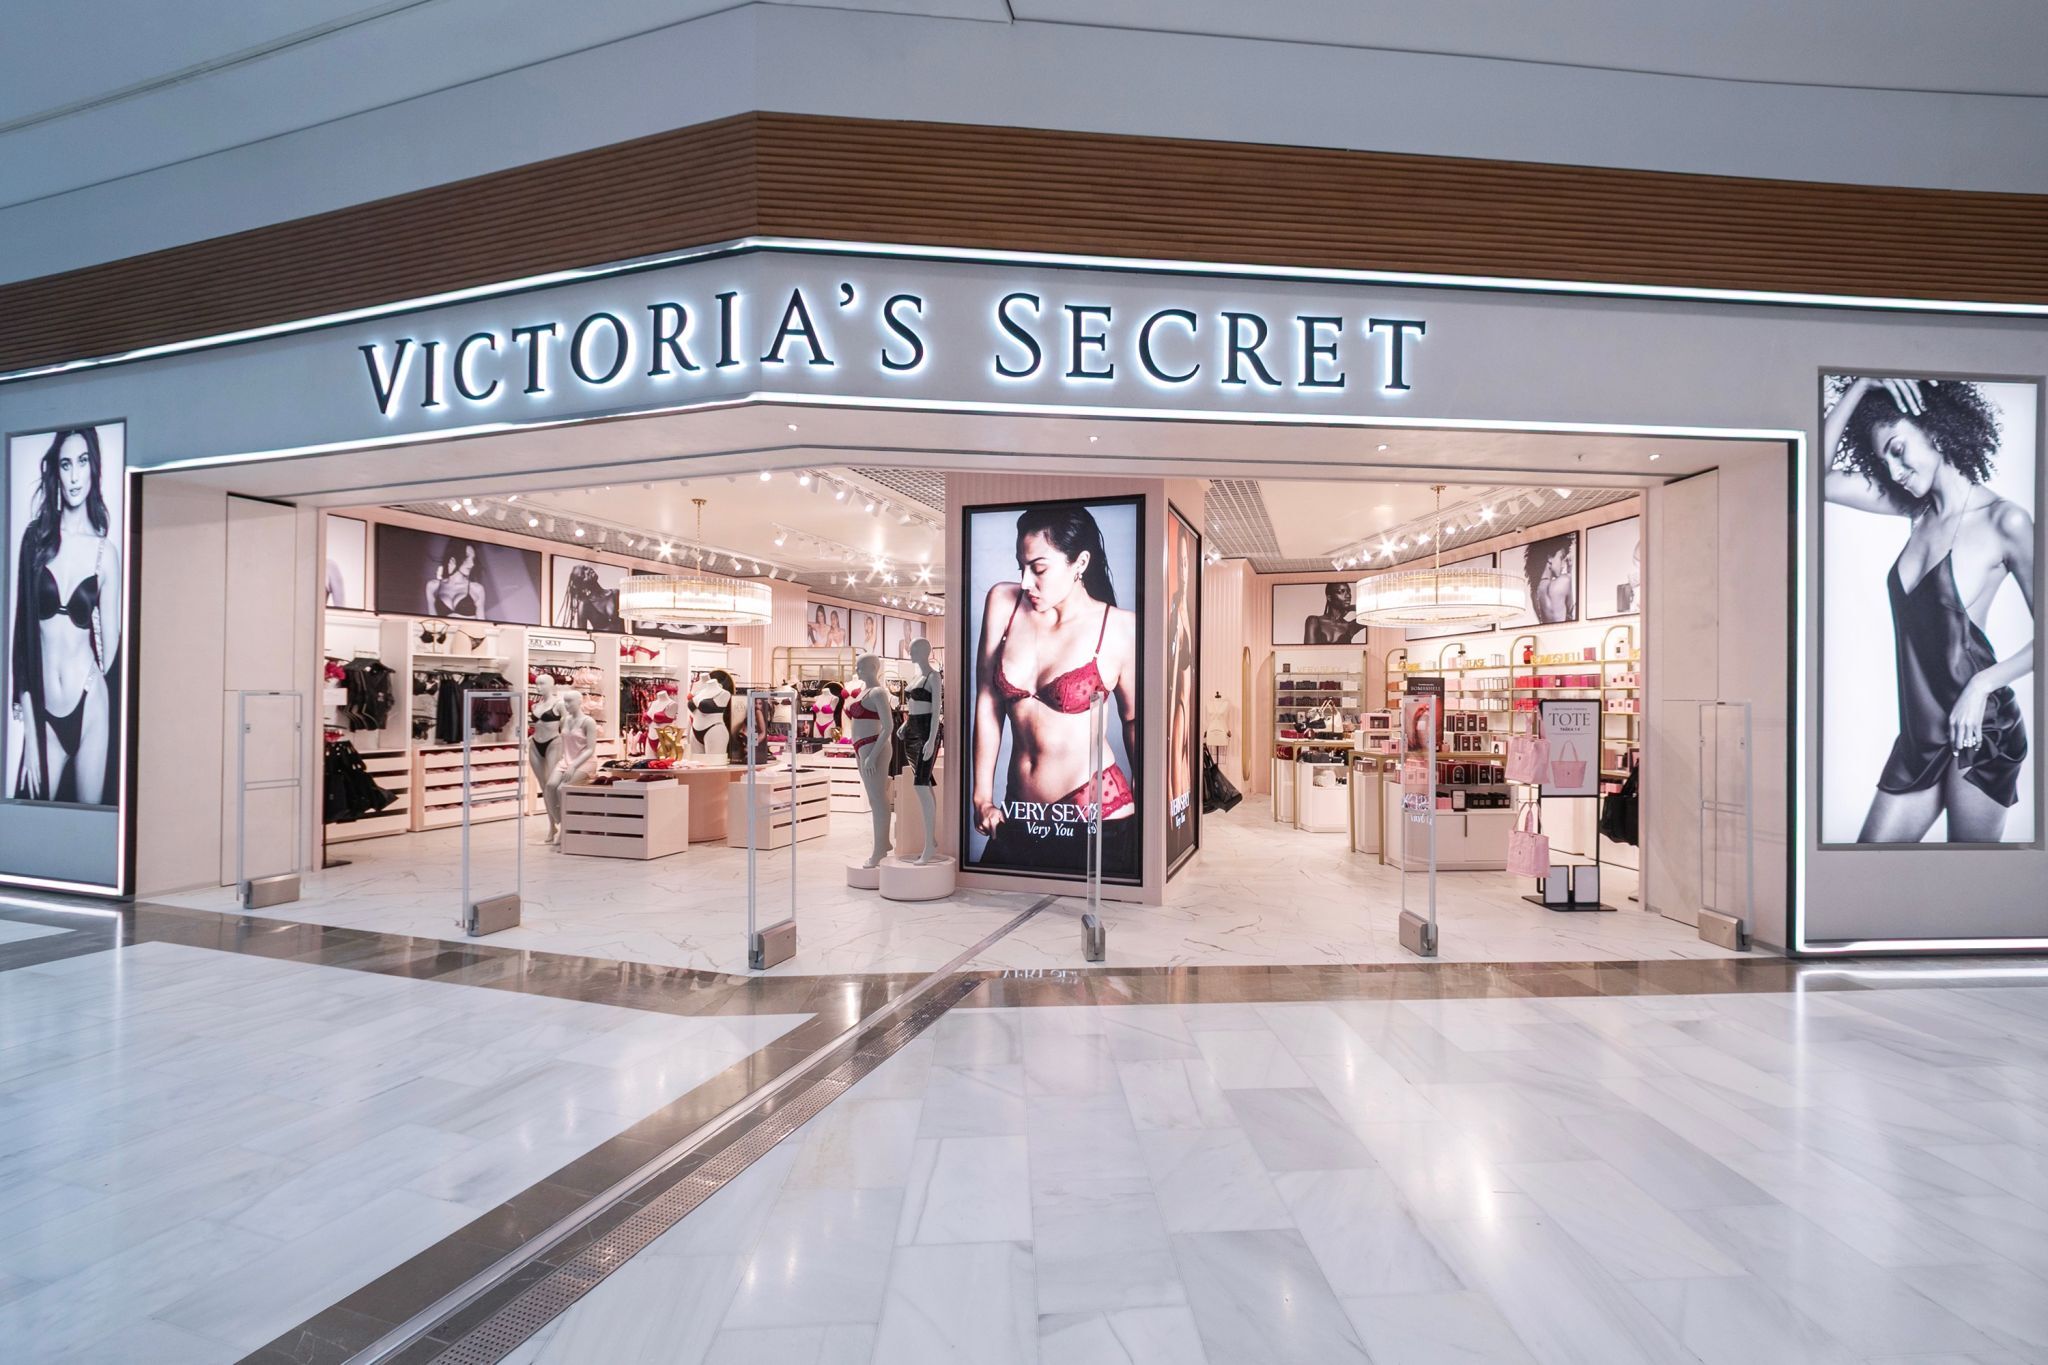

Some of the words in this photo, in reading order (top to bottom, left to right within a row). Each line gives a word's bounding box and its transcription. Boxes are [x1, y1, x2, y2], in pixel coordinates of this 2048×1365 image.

[358, 282, 925, 415] VICTORIA'S
[995, 292, 1427, 391] SECRET
[1548, 712, 1591, 727] TOTE
[1001, 801, 1048, 821] VERY
[1026, 821, 1051, 839] Very
[1053, 823, 1075, 837] You
